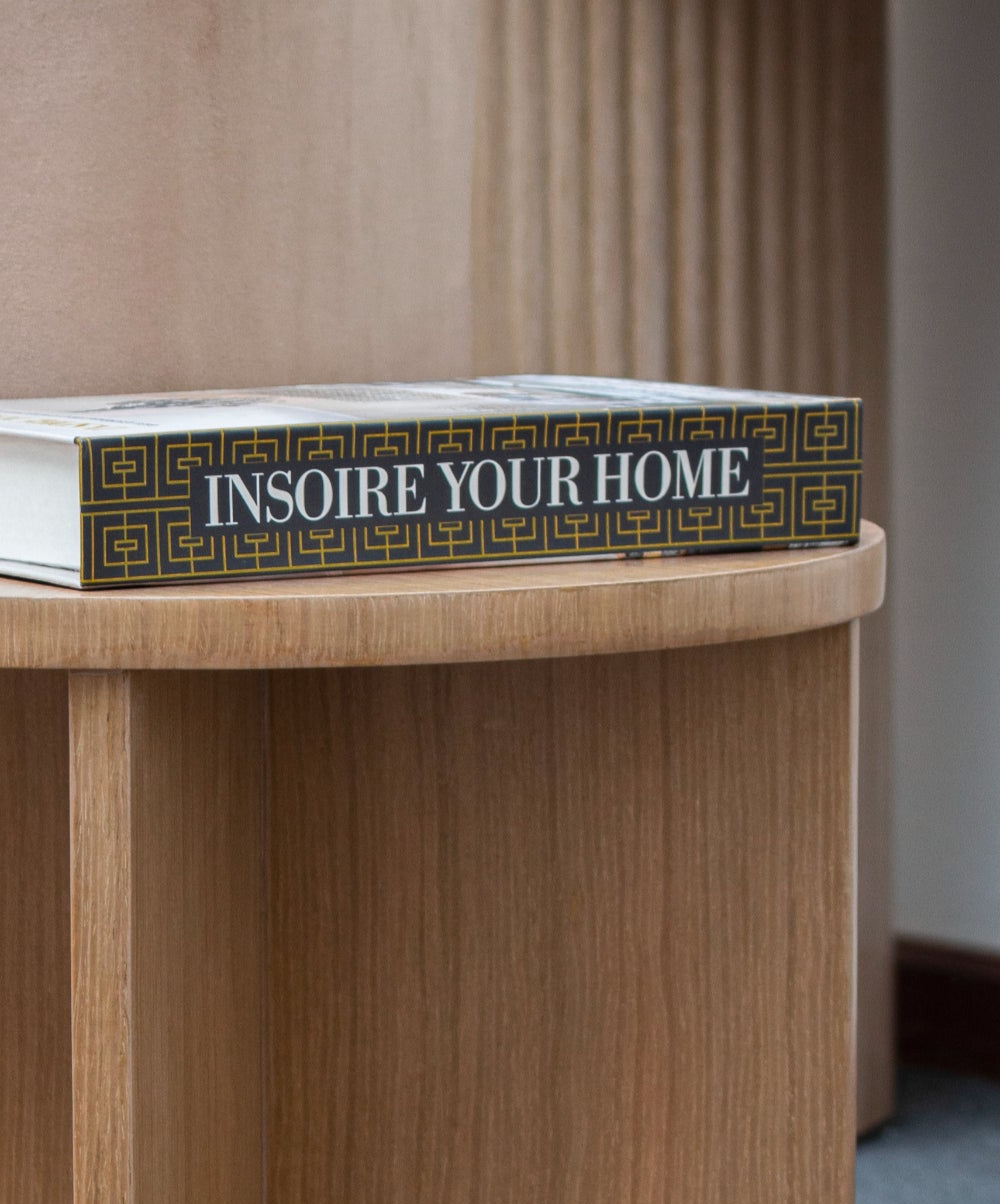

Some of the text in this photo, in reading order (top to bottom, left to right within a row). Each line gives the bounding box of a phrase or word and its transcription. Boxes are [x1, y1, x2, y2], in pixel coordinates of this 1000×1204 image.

[204, 447, 750, 527] INSOIRE YOUR HOME
